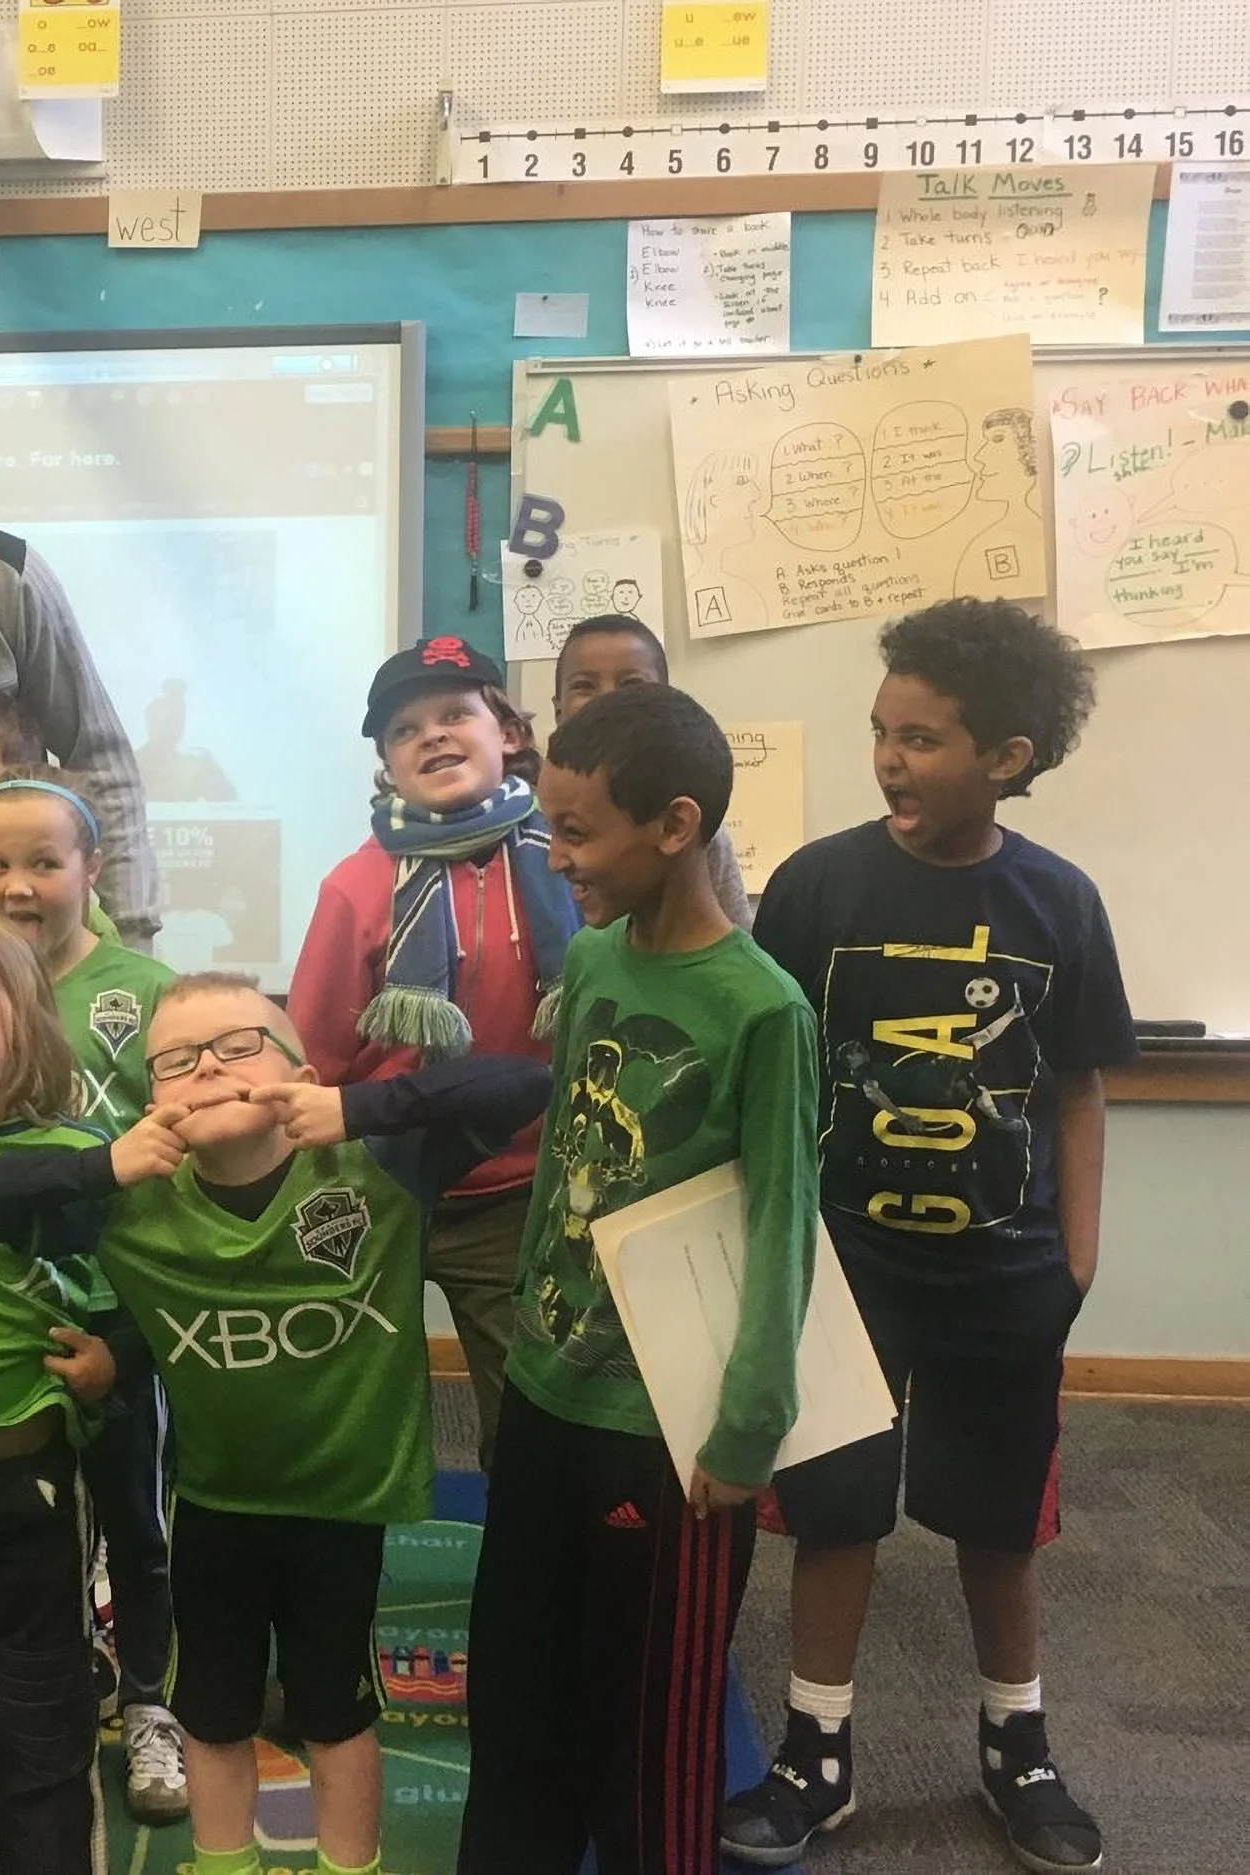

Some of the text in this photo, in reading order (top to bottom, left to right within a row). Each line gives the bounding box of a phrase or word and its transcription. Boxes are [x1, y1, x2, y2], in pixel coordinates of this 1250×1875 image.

[477, 130, 1244, 179] 1 2 3 4 5 6 7 8 9 10 11 12 13 14 15 16
[917, 173, 1066, 195] Talk Moves
[116, 196, 187, 242] west
[900, 208, 942, 222] Whole
[952, 206, 987, 227] body
[998, 203, 1063, 230] listening
[901, 232, 935, 246] Take
[943, 229, 992, 244] turns
[903, 260, 951, 281] Repeat
[962, 255, 1001, 273] back
[643, 281, 677, 292] Knee
[906, 288, 941, 305] Add
[715, 360, 911, 412] Asking Questions
[1131, 384, 1188, 411] BACK
[526, 376, 581, 443] A
[509, 493, 565, 561] B
[1150, 528, 1204, 549] heard
[832, 554, 890, 575] question
[994, 554, 1012, 574] B
[1115, 550, 1180, 571] you say
[705, 594, 725, 619] A
[1113, 584, 1183, 605] thinking
[162, 827, 214, 846] 10%
[868, 925, 991, 1235] GOAL
[156, 1270, 398, 1370] XBOX
